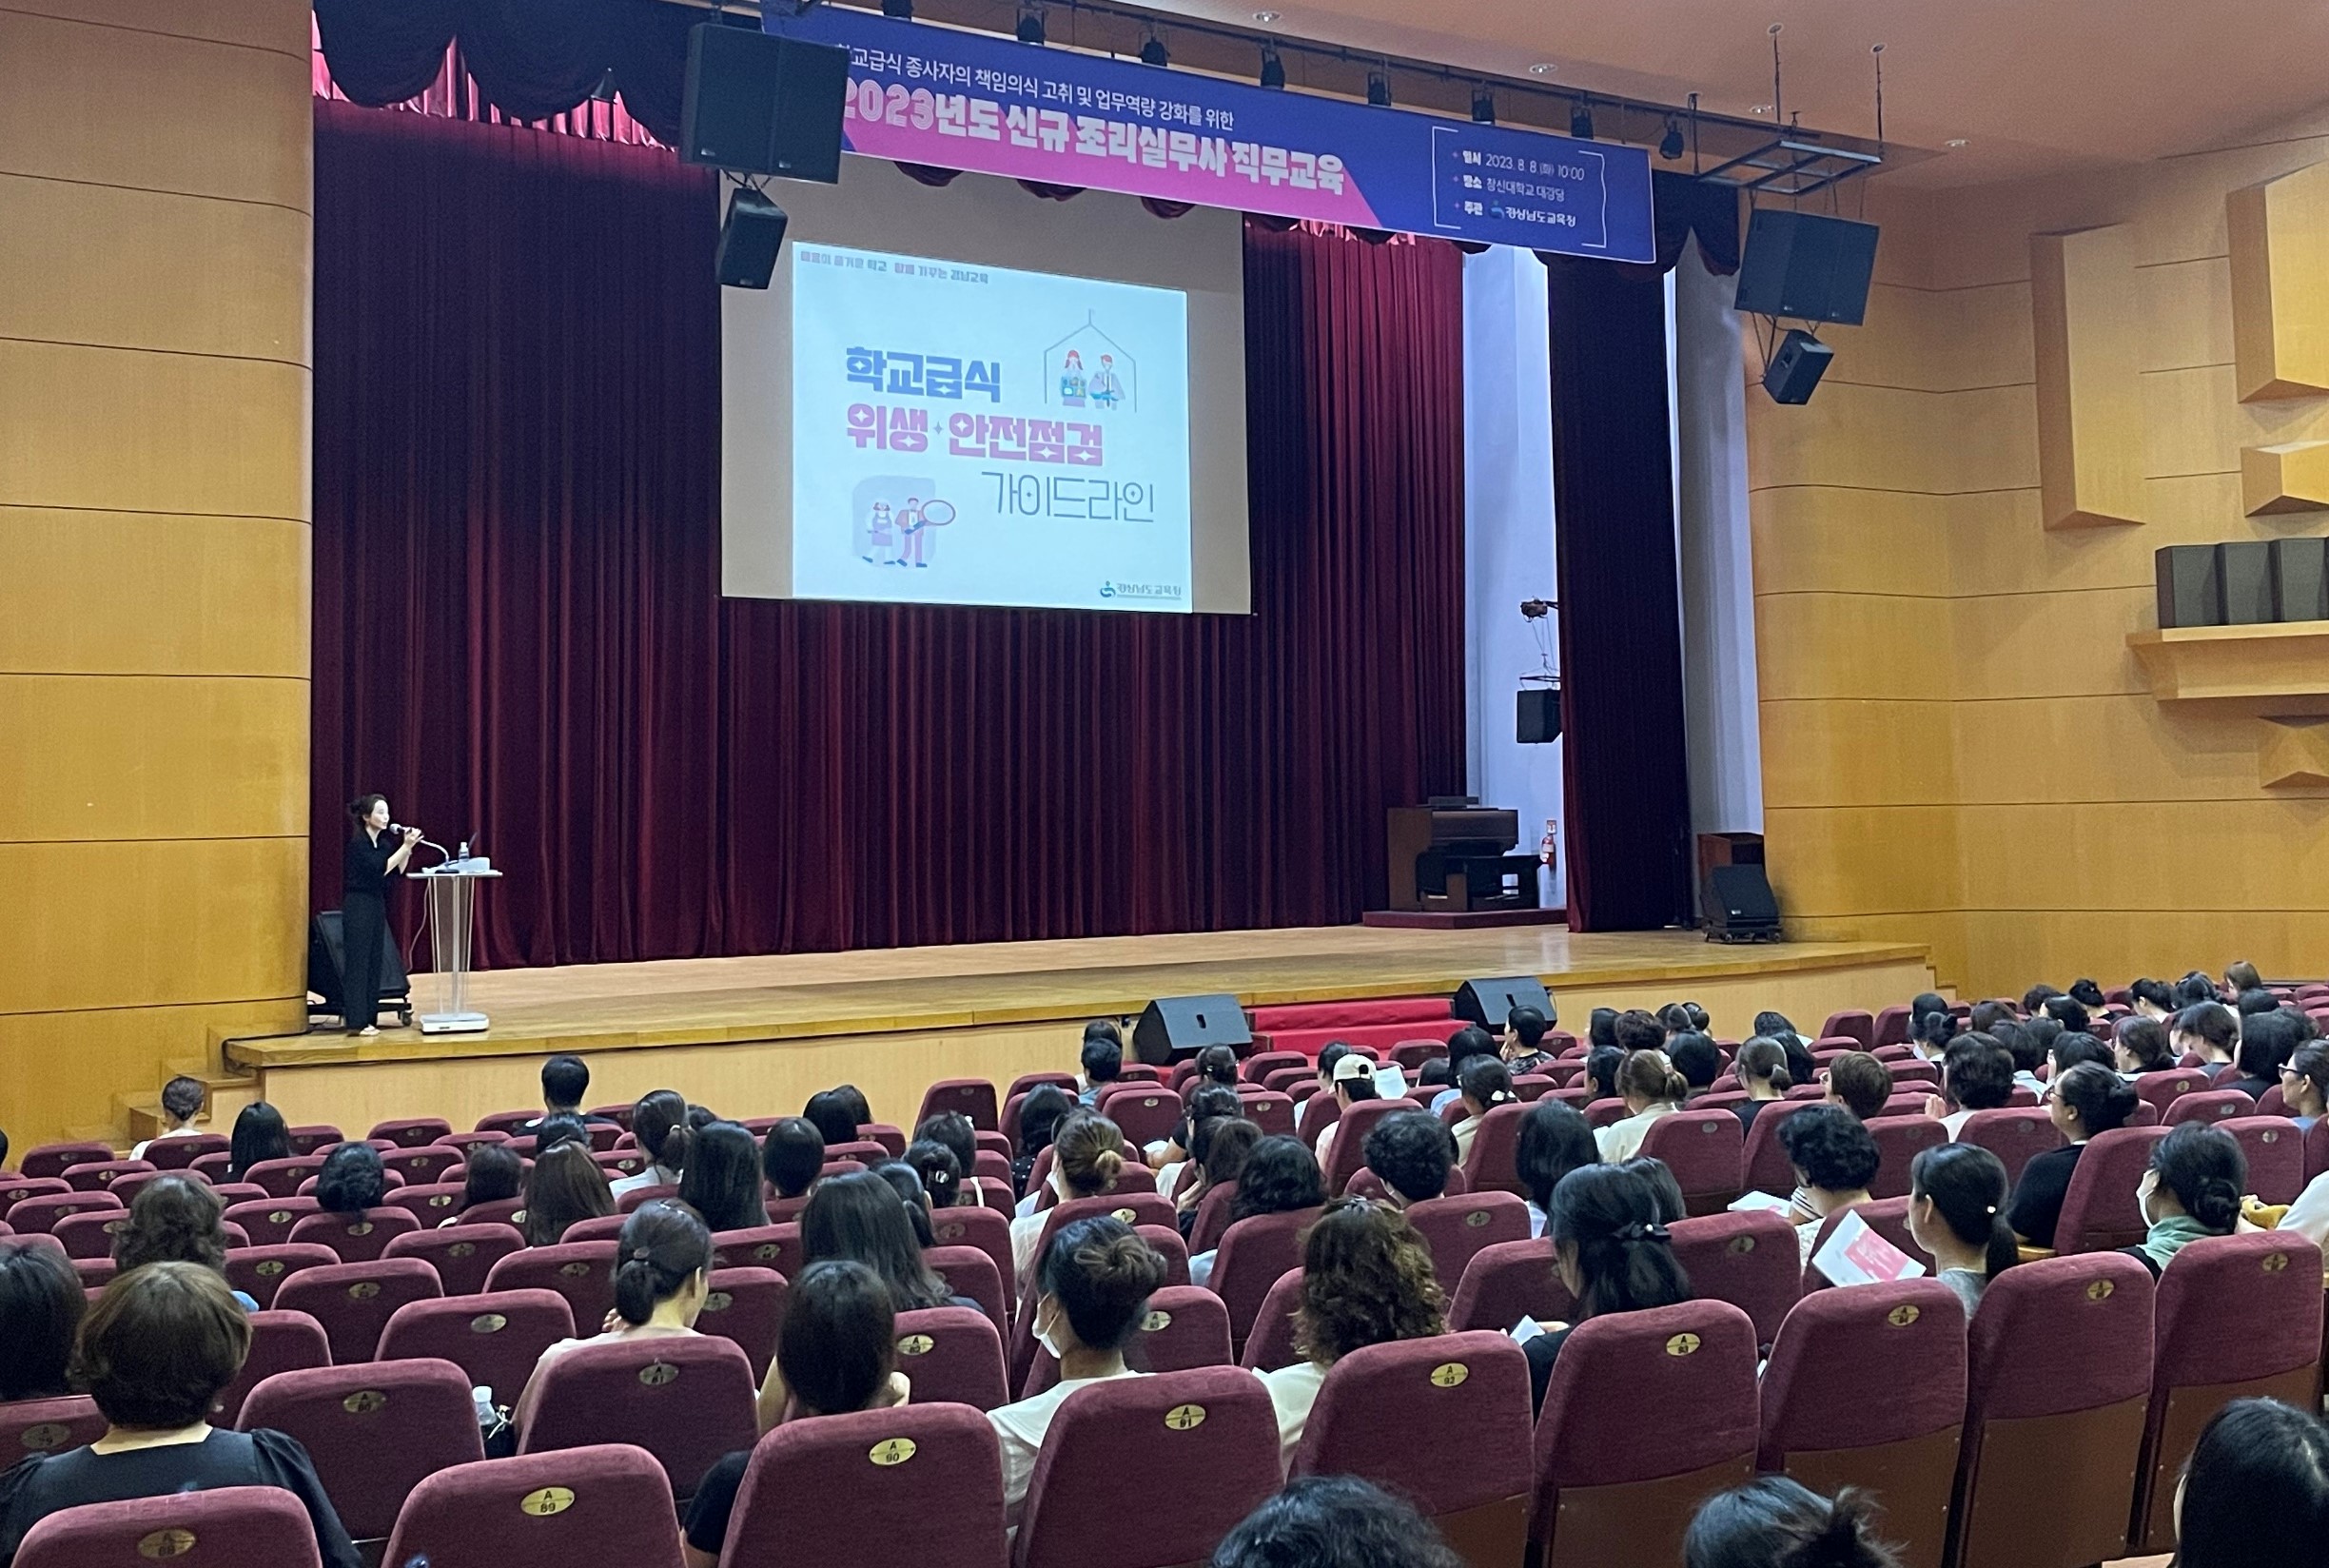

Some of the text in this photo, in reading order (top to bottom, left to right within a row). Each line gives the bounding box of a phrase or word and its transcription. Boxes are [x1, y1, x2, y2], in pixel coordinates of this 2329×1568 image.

[839, 44, 1234, 131] 교급식 종사자의 책임의식 고취 및 업무역량 강화를 위한
[1006, 104, 1070, 154] 신규
[1076, 115, 1227, 178] 조리실무사
[1231, 141, 1344, 196] 직무교육
[1505, 206, 1576, 227] 경상남도교육청
[846, 346, 1001, 403] 학교급식
[847, 402, 1104, 467] 위생 안전점검
[981, 471, 1154, 523] 가이드라인
[886, 1453, 900, 1463] 90
[890, 1441, 897, 1450] A
[539, 1502, 557, 1513] 89
[543, 1490, 553, 1500] A
